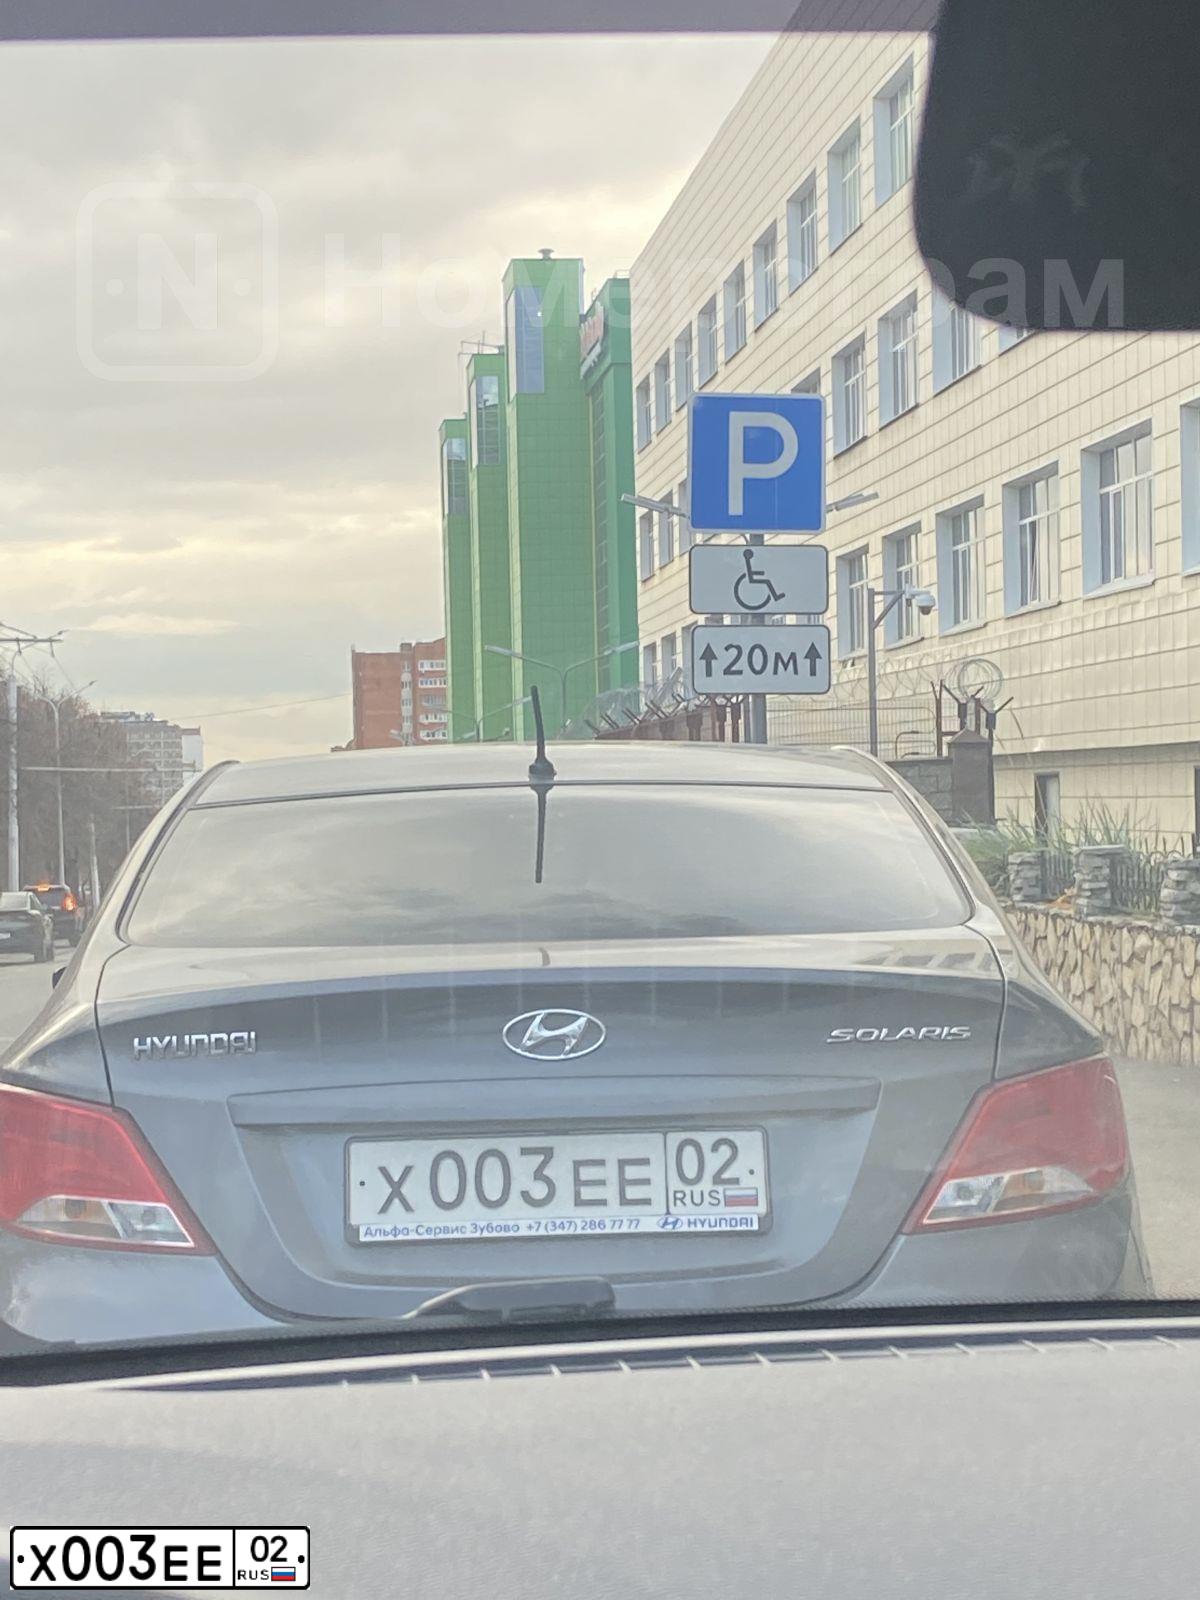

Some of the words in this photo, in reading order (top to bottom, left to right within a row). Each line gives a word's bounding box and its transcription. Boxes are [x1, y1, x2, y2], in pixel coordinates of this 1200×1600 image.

[728, 411, 799, 517] P
[826, 1026, 972, 1044] SOLARIS
[133, 1031, 256, 1060] HYUNDAI
[675, 1138, 741, 1186] 02
[672, 1189, 722, 1208] RUS
[363, 1223, 467, 1239] Альфа-Сервис
[470, 1222, 520, 1236] Зубово
[526, 1221, 541, 1232] +7
[544, 1219, 577, 1233] (347)
[581, 1219, 606, 1231] 286
[687, 1216, 754, 1229] HYUNDAI
